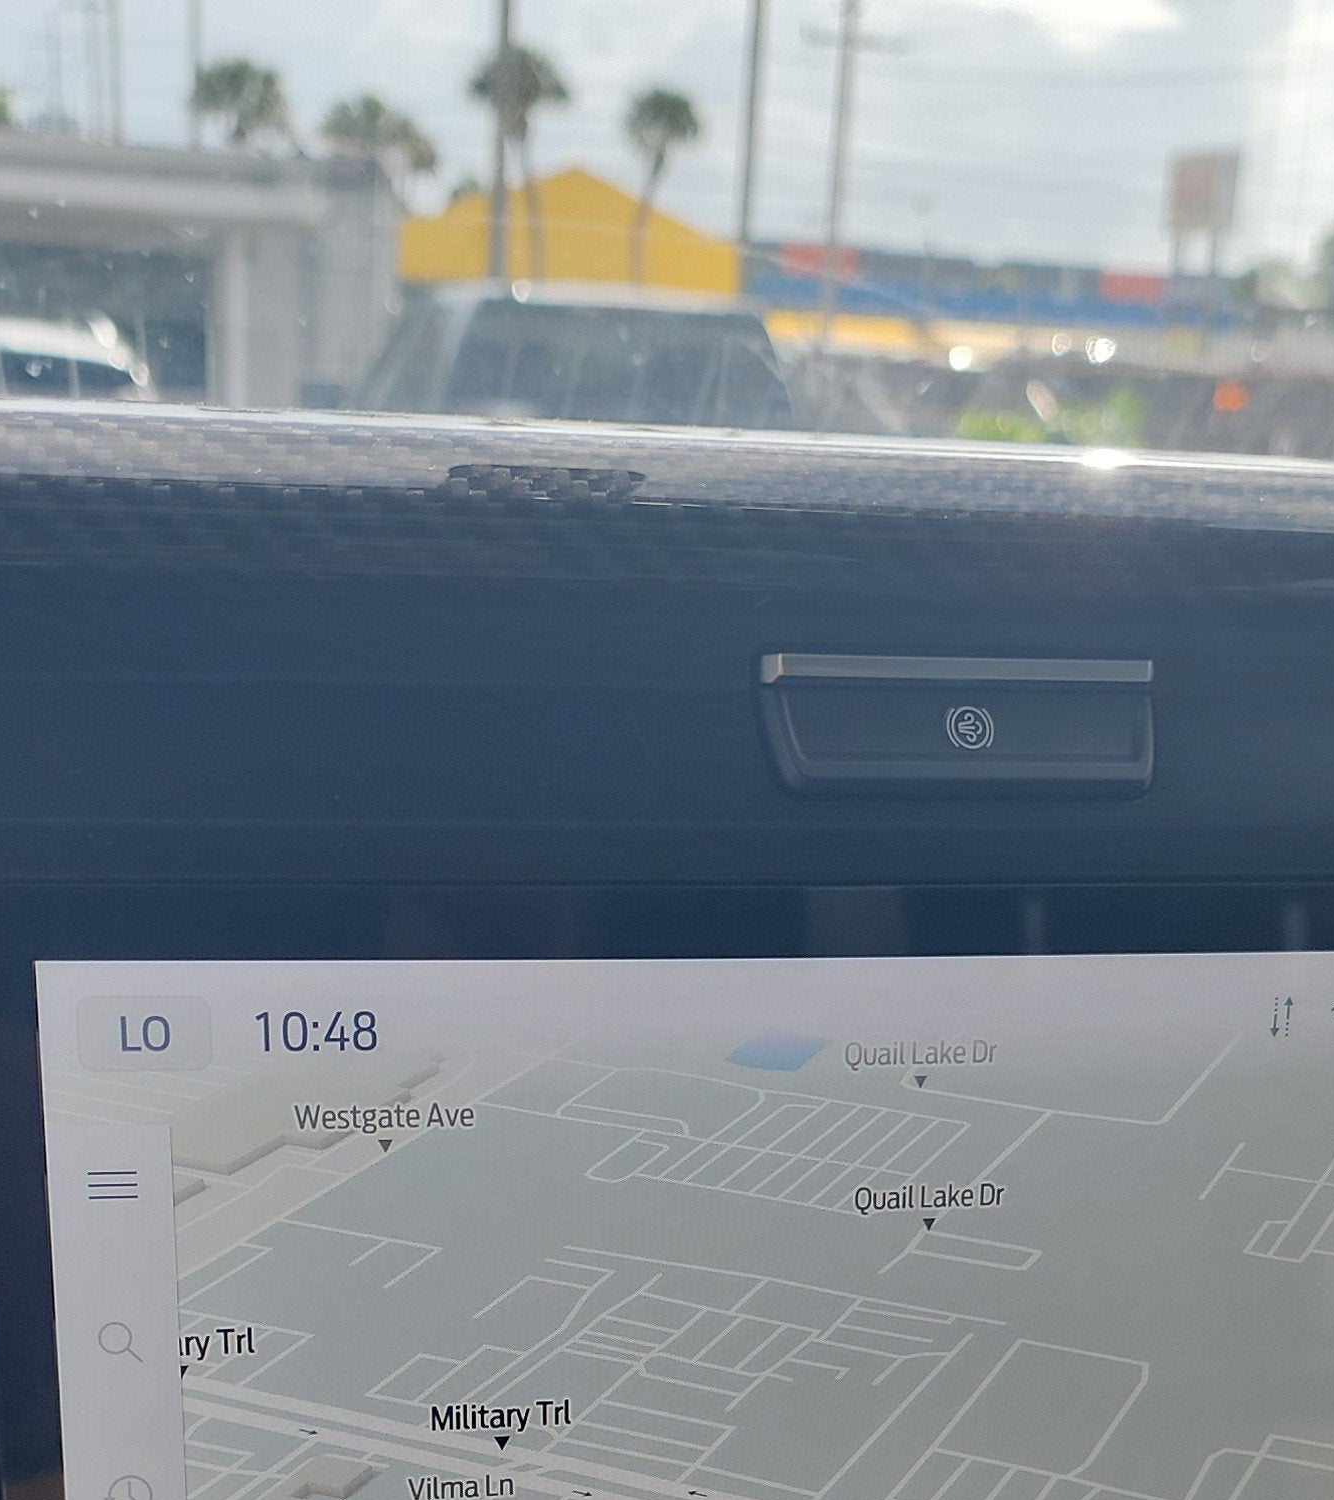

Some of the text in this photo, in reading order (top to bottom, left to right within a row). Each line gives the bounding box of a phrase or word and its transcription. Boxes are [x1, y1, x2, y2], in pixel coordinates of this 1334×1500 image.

[119, 1014, 172, 1053] LO
[254, 1010, 379, 1053] 10:48
[844, 1039, 998, 1071] Quail Lake Dr
[293, 1102, 475, 1134] Westgate Ave
[854, 1182, 1005, 1216] Quail Lake Dr
[215, 1326, 256, 1355] Trl
[431, 1398, 572, 1433] Military Trl
[407, 1473, 514, 1500] Vilma Ln
